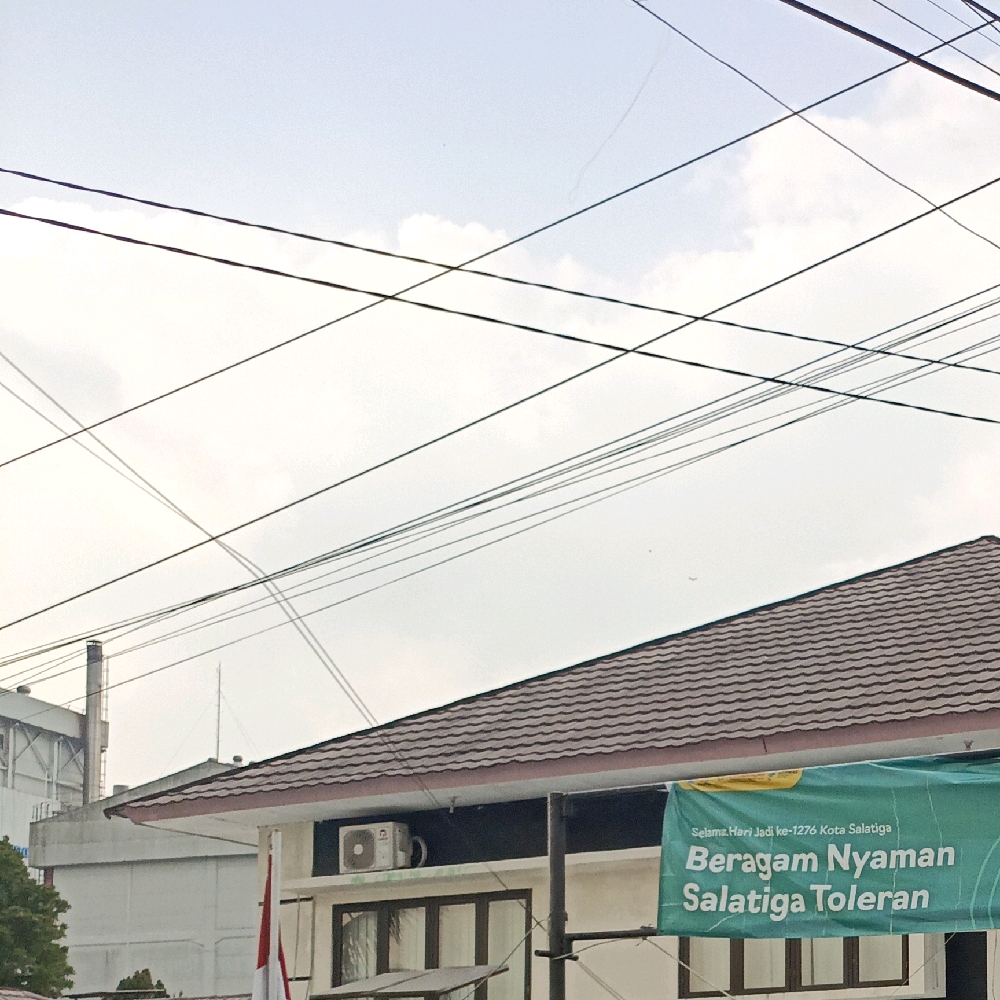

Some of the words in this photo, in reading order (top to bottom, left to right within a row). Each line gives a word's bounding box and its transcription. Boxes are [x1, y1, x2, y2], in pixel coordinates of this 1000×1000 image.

[692, 827, 729, 839] Selama
[728, 826, 753, 837] Hari
[754, 825, 774, 838] Jadi
[776, 825, 817, 837] ke-1276
[819, 824, 846, 836] Kota
[848, 822, 892, 837] Salatiga
[685, 845, 818, 881] Beragam
[827, 843, 955, 879] Nyaman
[683, 883, 806, 922] Salatiga
[810, 884, 930, 912] Toleran
